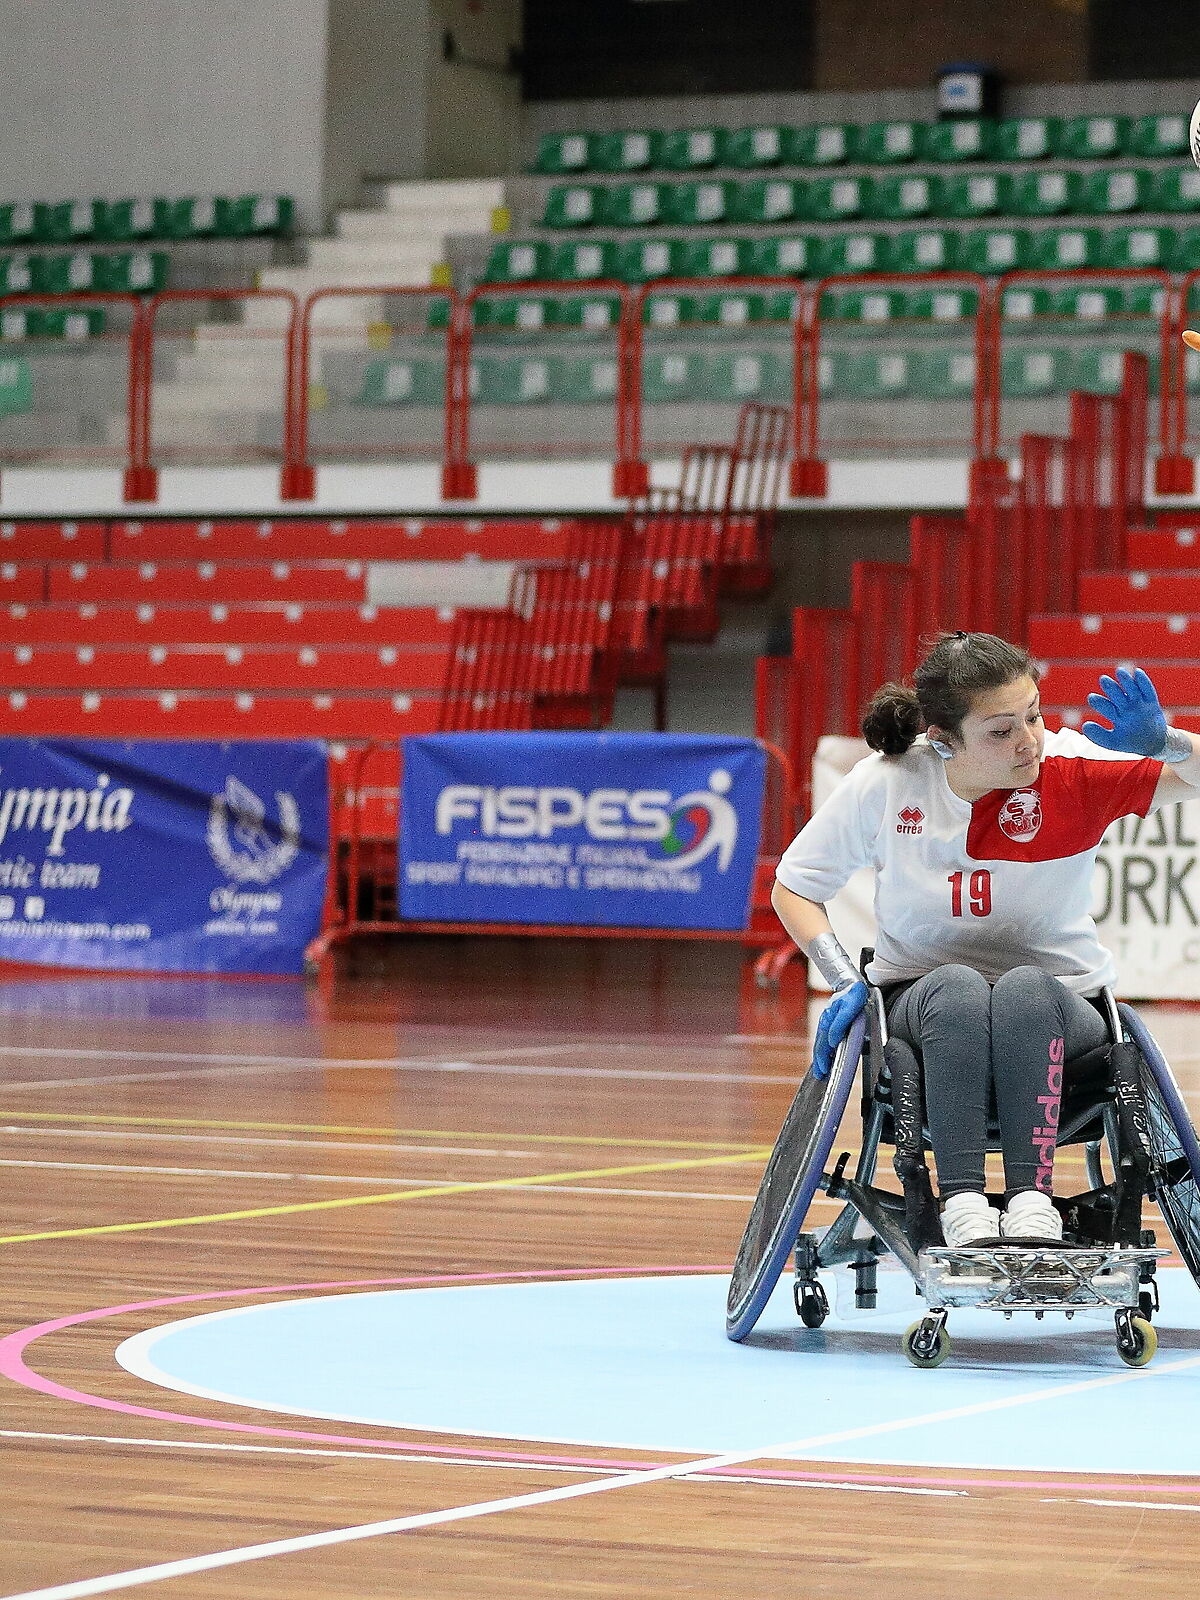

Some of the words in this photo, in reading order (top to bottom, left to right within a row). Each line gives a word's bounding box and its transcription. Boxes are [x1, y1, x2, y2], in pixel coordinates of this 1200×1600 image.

[0, 766, 135, 856] ympia
[436, 784, 673, 840] FISPES
[948, 869, 992, 917] 19
[1031, 1037, 1064, 1191] adidas
